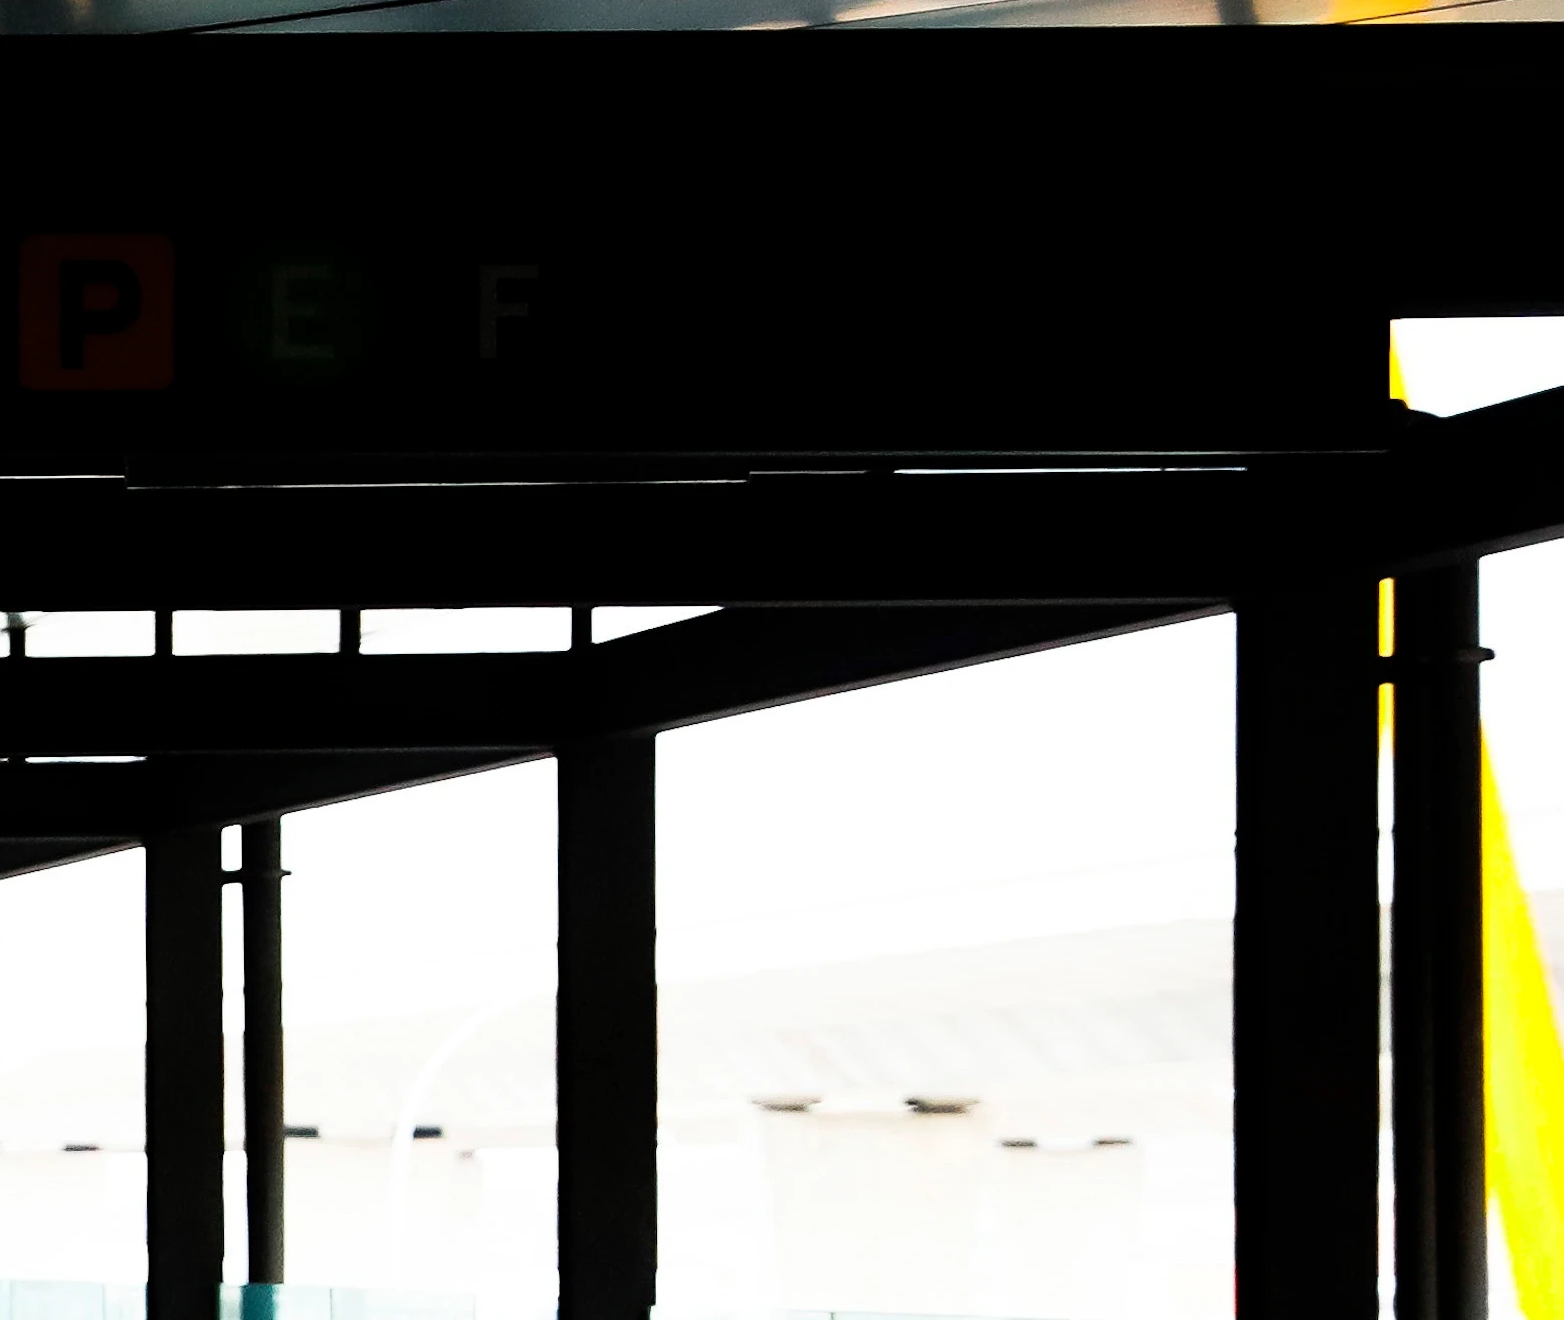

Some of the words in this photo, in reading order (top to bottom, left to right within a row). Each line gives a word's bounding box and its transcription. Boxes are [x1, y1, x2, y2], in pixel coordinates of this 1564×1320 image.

[60, 260, 141, 369] P
[272, 264, 335, 361] E
[479, 263, 540, 359] F
